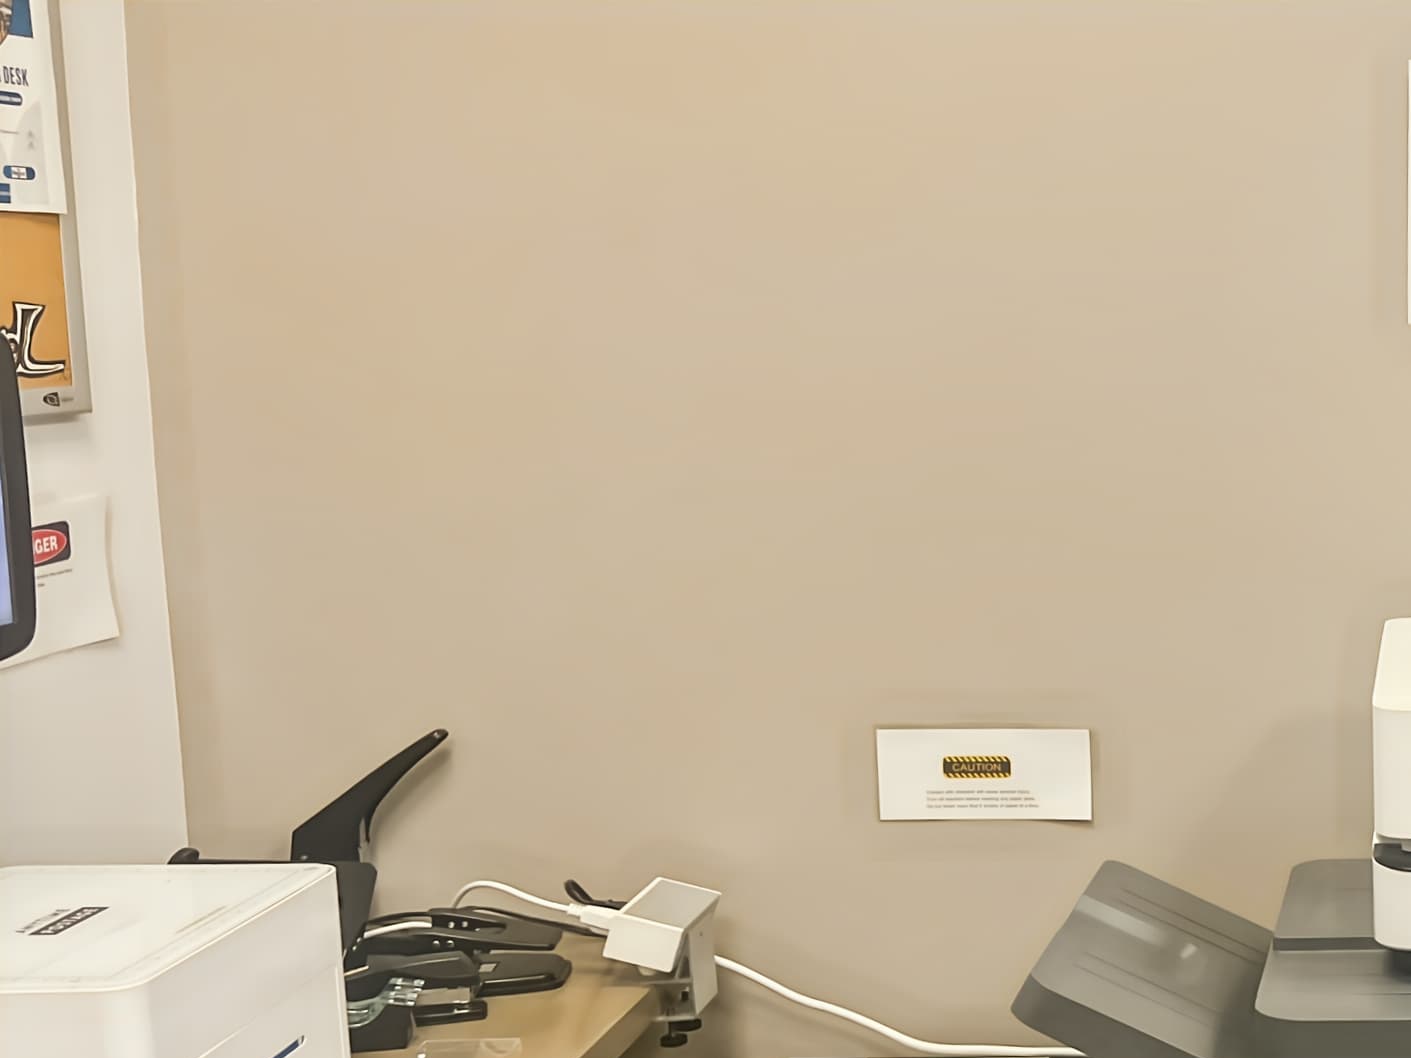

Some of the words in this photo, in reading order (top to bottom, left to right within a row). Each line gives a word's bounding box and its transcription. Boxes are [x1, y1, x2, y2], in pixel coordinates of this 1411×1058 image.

[3, 65, 29, 86] DESK
[35, 535, 58, 554] GER
[952, 763, 1001, 772] CAUTION
